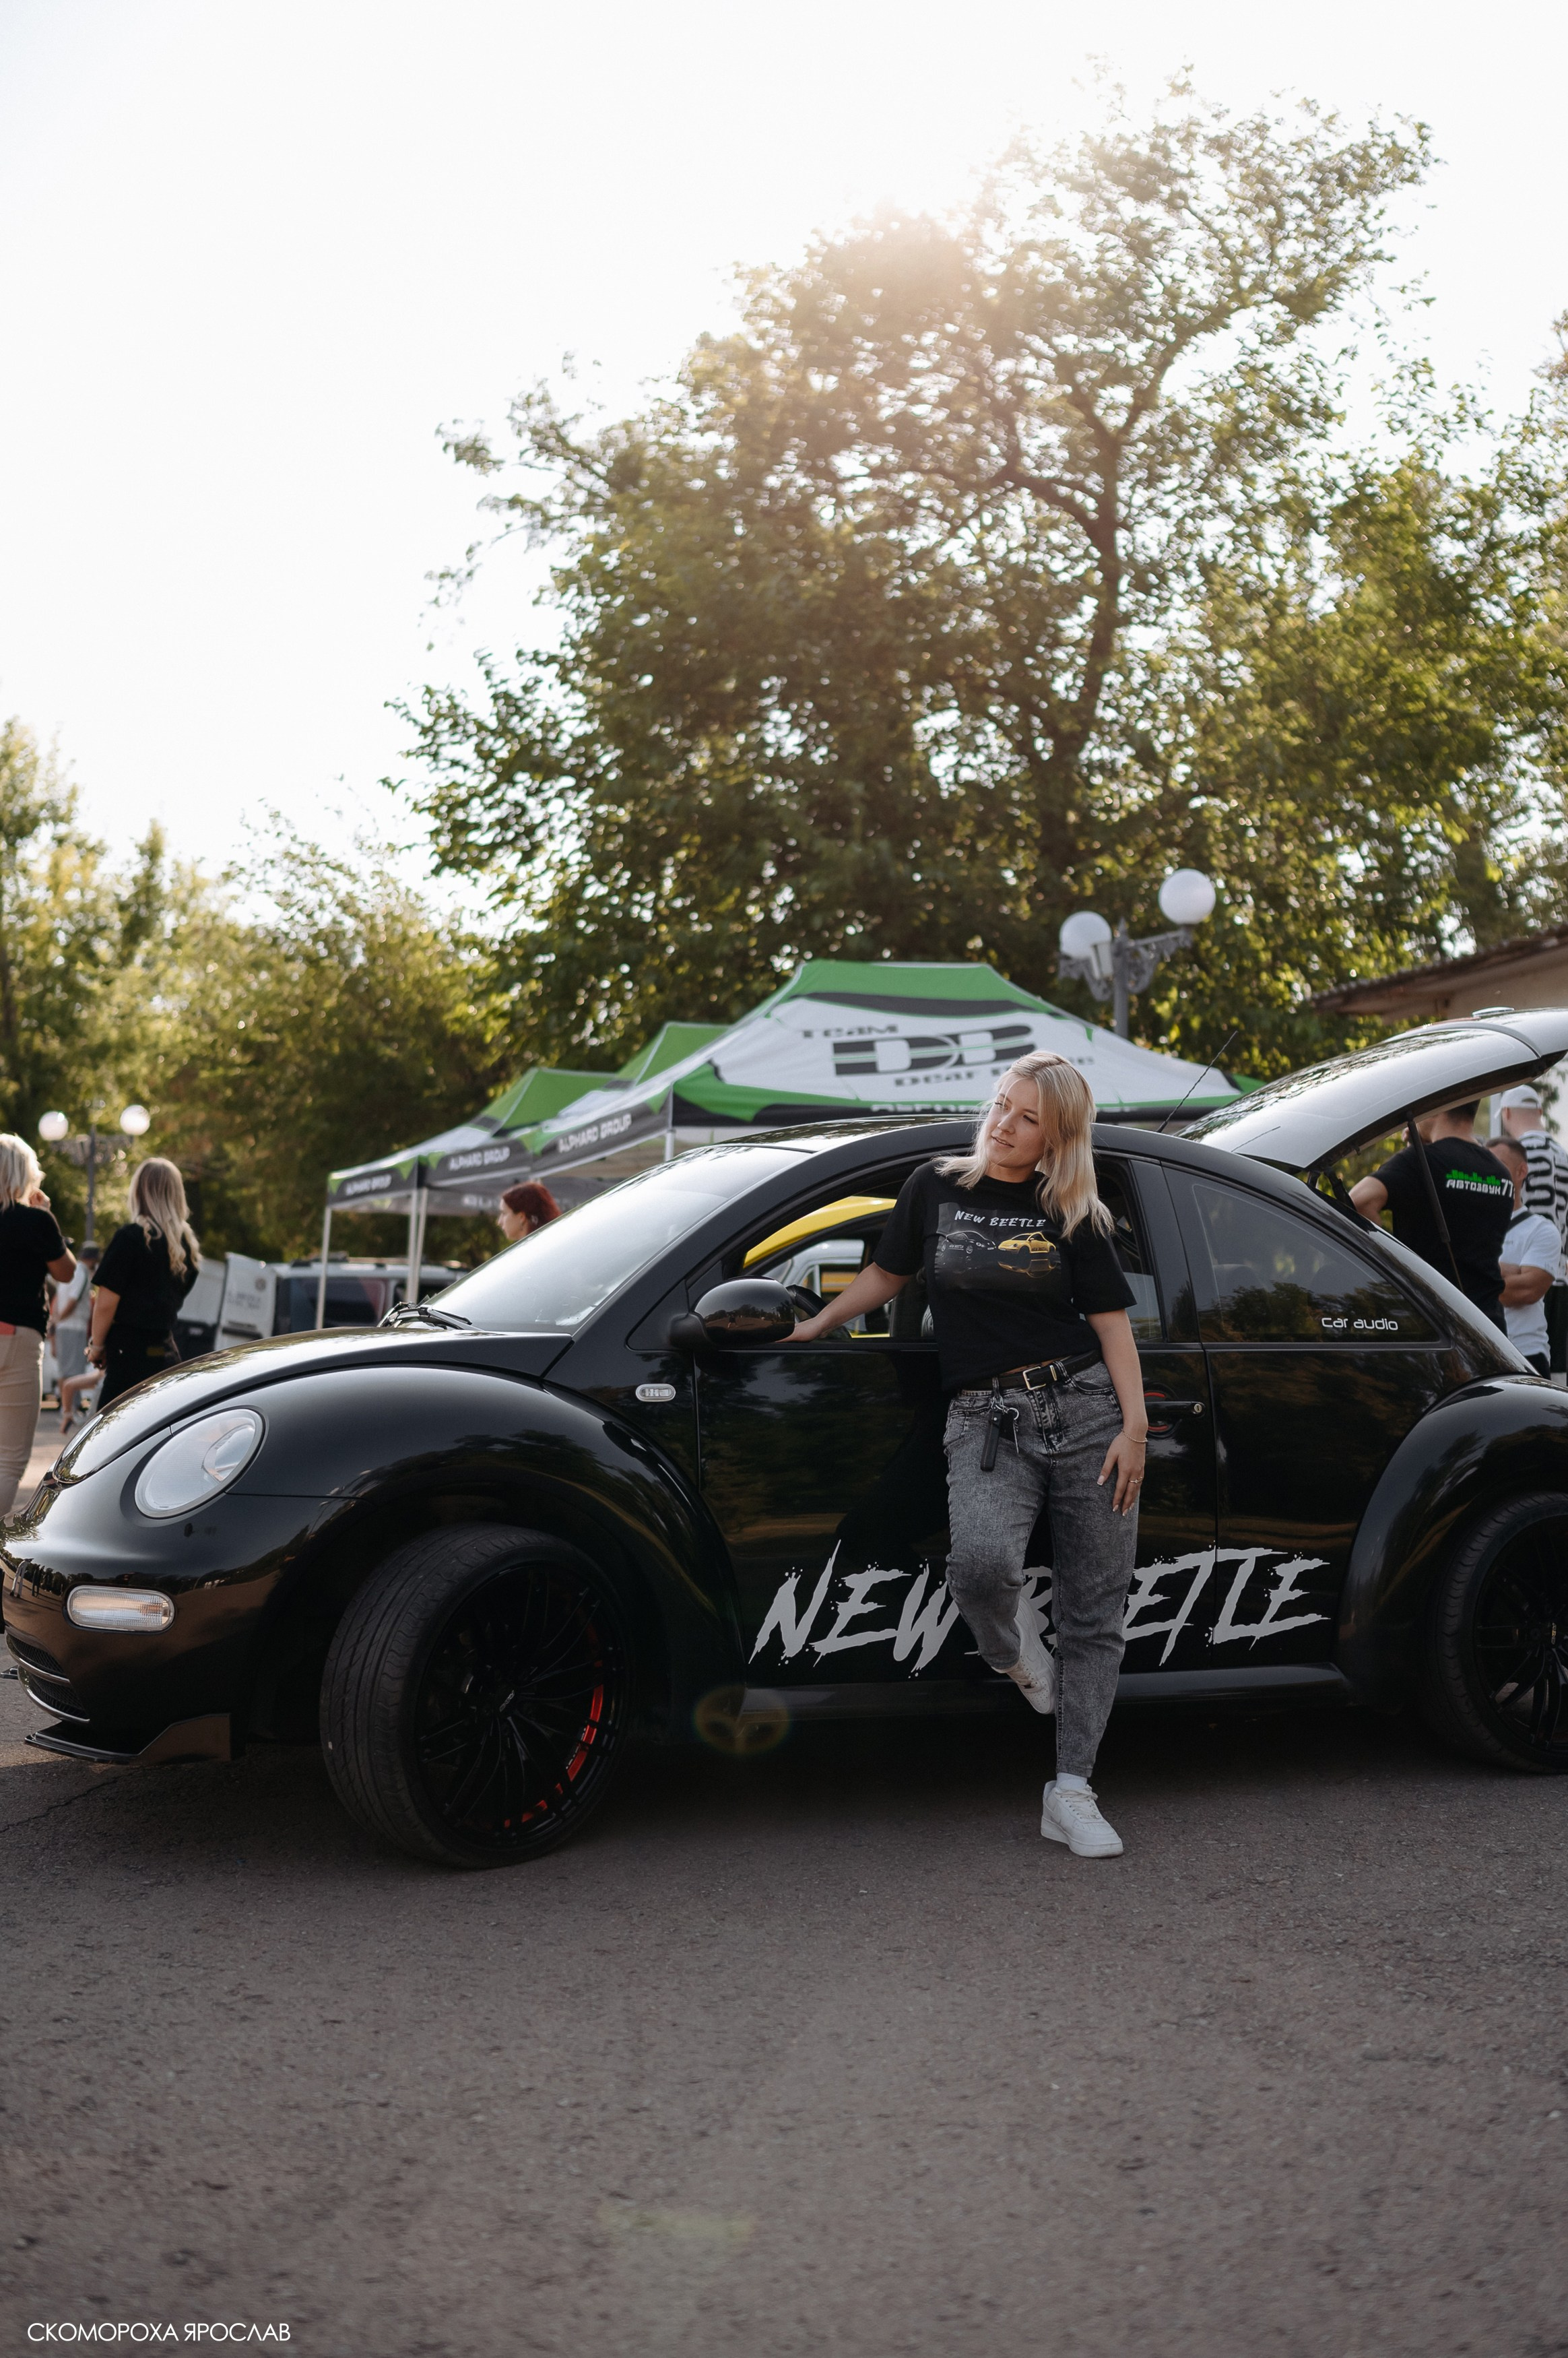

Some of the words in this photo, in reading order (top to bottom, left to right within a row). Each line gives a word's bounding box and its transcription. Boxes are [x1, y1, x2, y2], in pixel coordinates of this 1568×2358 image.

[599, 1114, 632, 1139] GROUP
[954, 1210, 985, 1223] NEW
[989, 1217, 1046, 1228] BEETLE
[1321, 1317, 1348, 1328] car
[1353, 1318, 1398, 1331] audio
[748, 1539, 960, 1678] NEW
